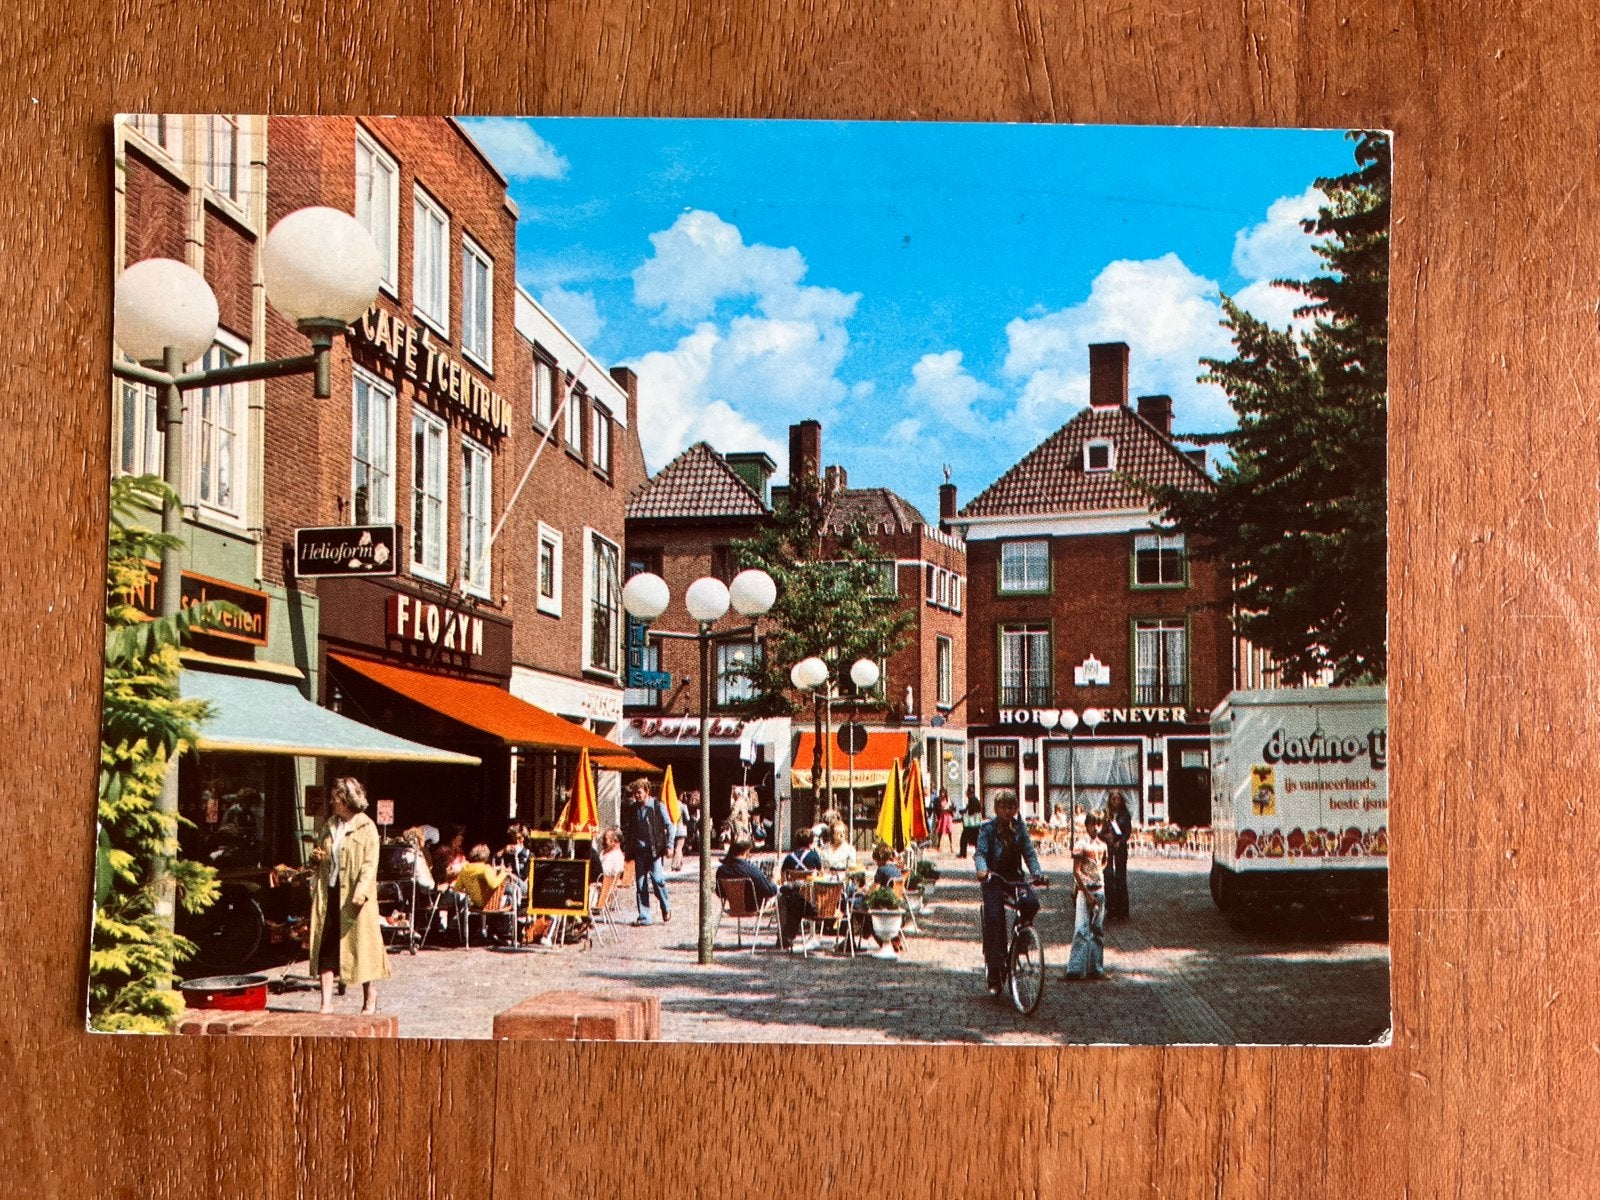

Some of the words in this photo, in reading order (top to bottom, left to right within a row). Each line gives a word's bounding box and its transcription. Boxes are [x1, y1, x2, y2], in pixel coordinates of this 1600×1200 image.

[437, 351, 513, 438] CENTRUM
[301, 541, 373, 564] Helioform
[397, 593, 484, 657] FLORYN
[1084, 708, 1187, 725] ENEVER
